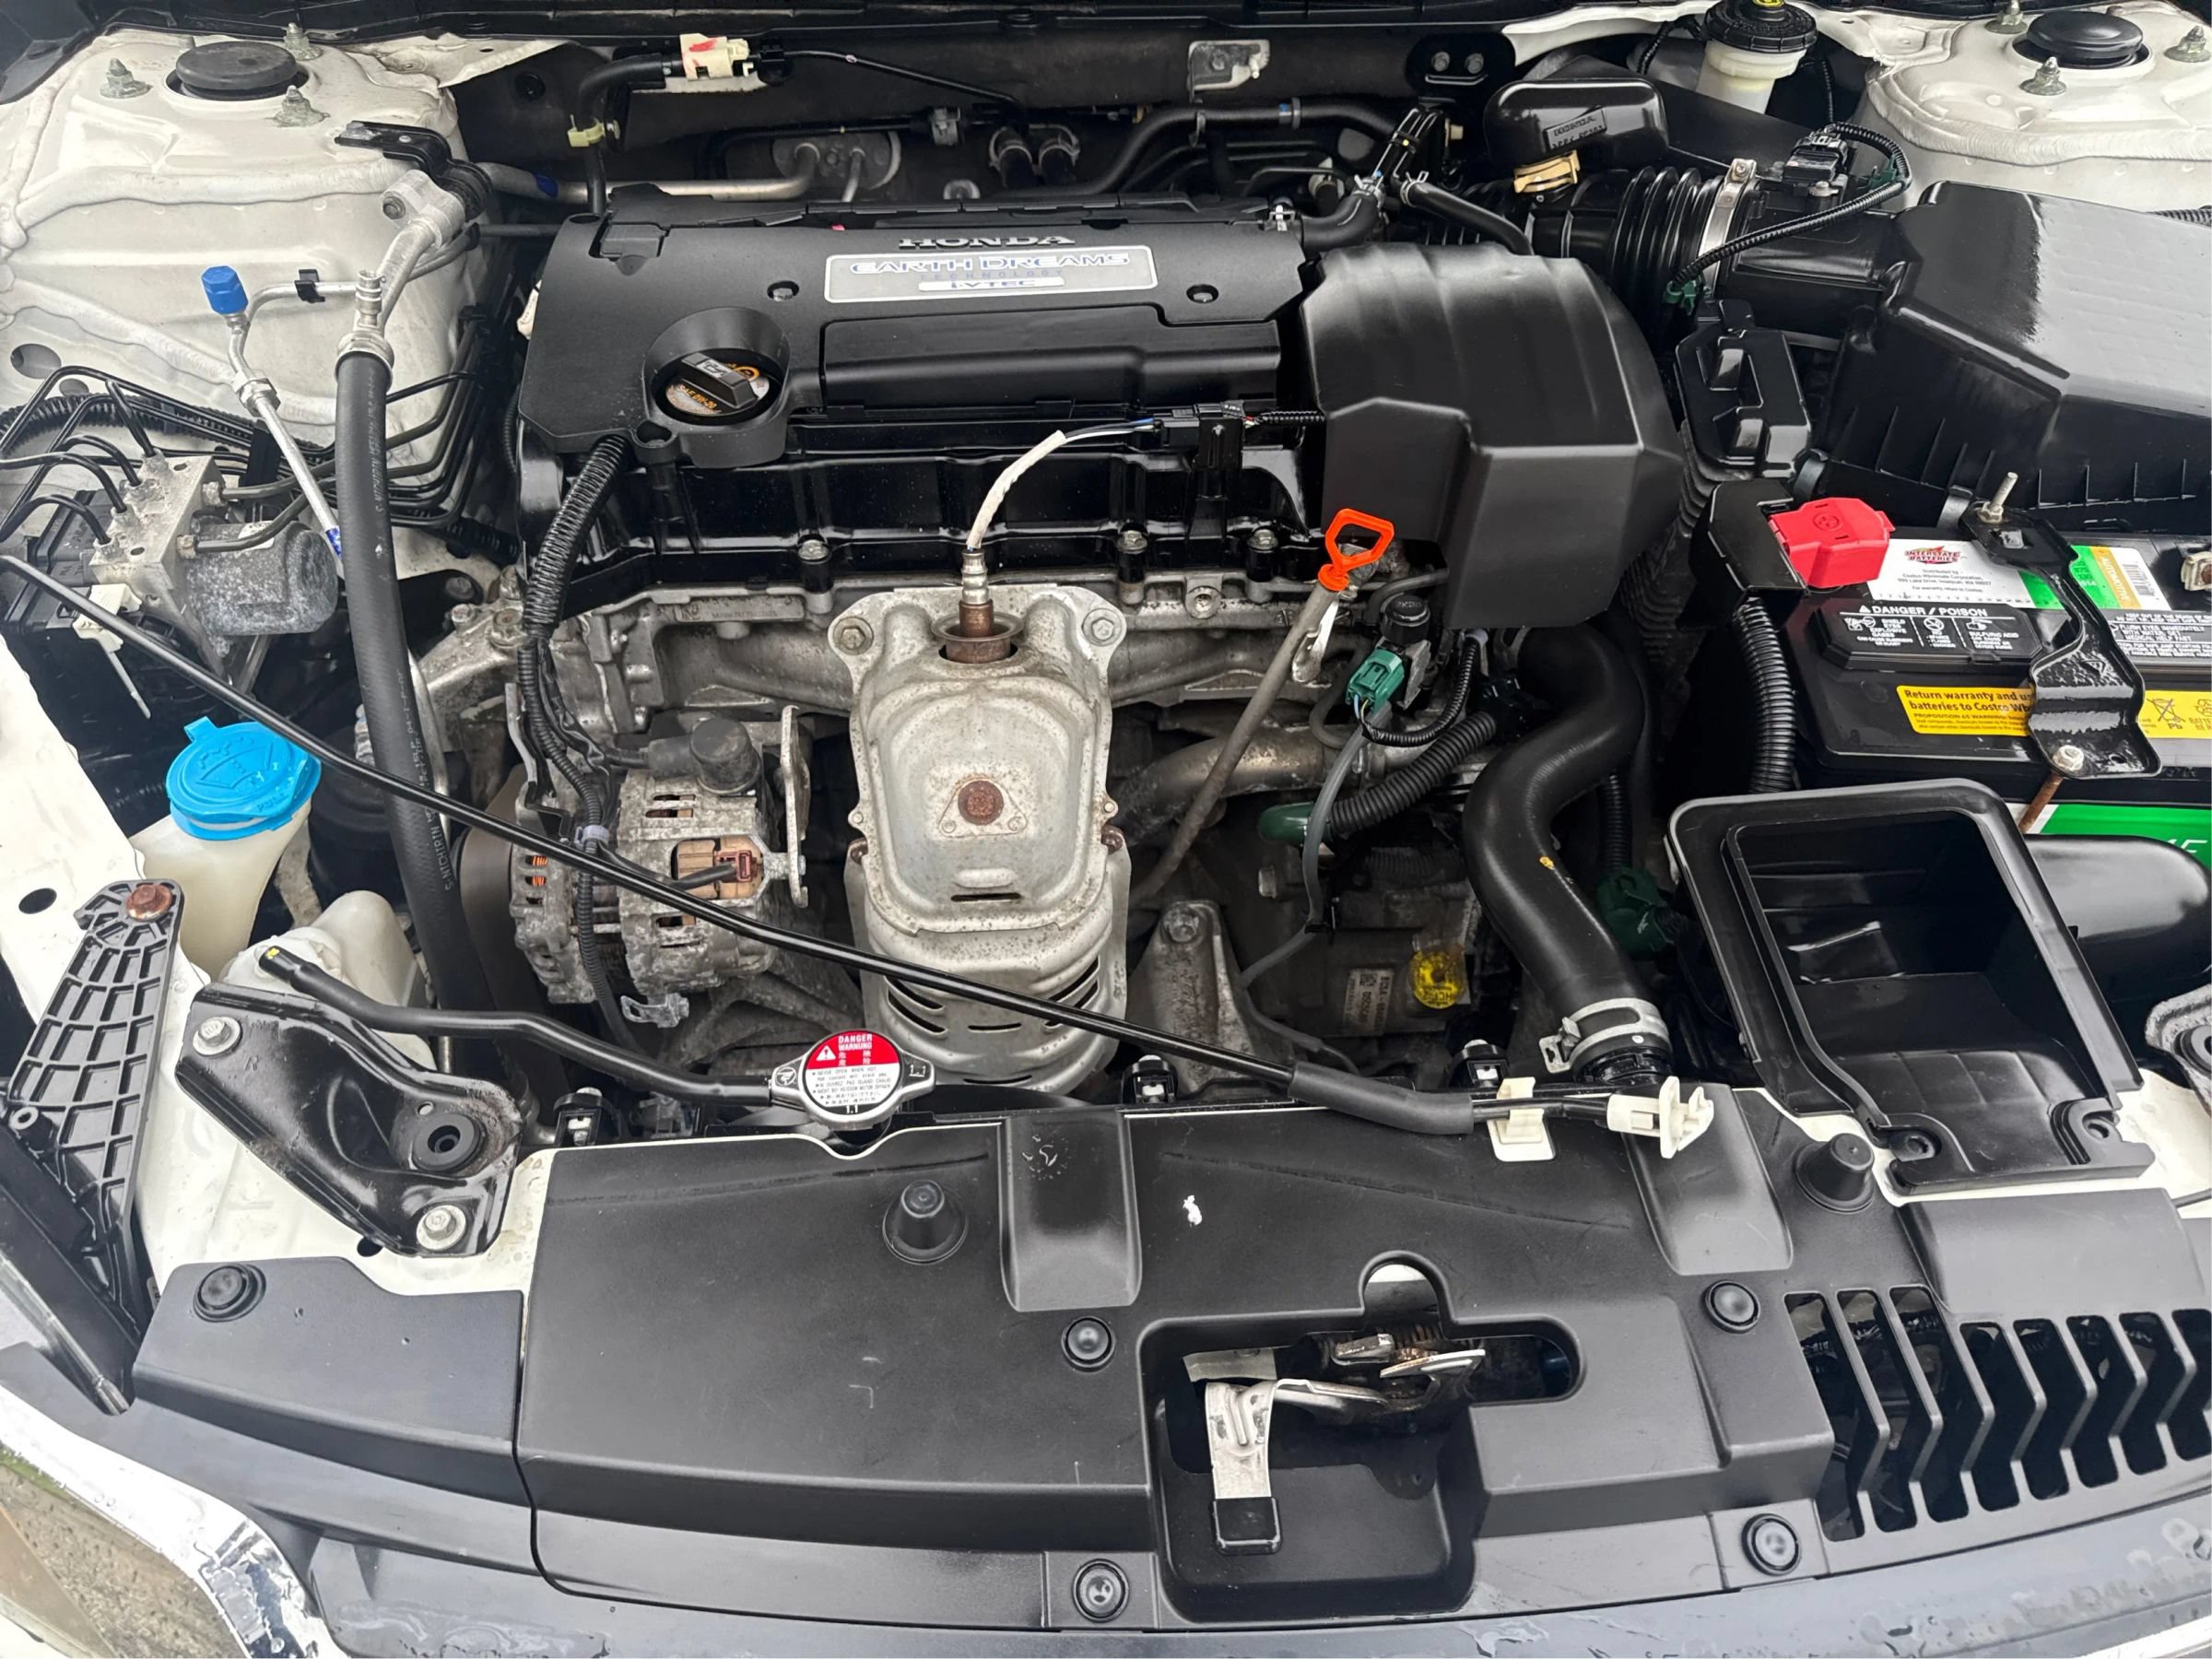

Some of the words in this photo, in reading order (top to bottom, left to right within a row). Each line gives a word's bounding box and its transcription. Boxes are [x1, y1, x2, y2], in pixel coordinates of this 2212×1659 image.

[899, 235, 1076, 250] HONDA
[851, 255, 973, 274] EARTH
[979, 252, 1131, 270] DREAMS
[922, 269, 1063, 279] TECHNOLOGY
[677, 382, 695, 396] SAE
[2100, 557, 2131, 602] AUTOMOTIVE
[1872, 606, 1926, 615] DANGER
[1928, 606, 1936, 615] /
[1938, 607, 1988, 617] POISON
[1904, 689, 1942, 700] Return
[1945, 691, 1994, 701] warranty
[1997, 691, 2018, 700] and
[1909, 700, 1959, 711] batteries
[1959, 701, 1972, 711] to
[1973, 702, 2009, 712] Costco
[838, 1033, 873, 1043] DANGER
[846, 1105, 859, 1114] 1.1
